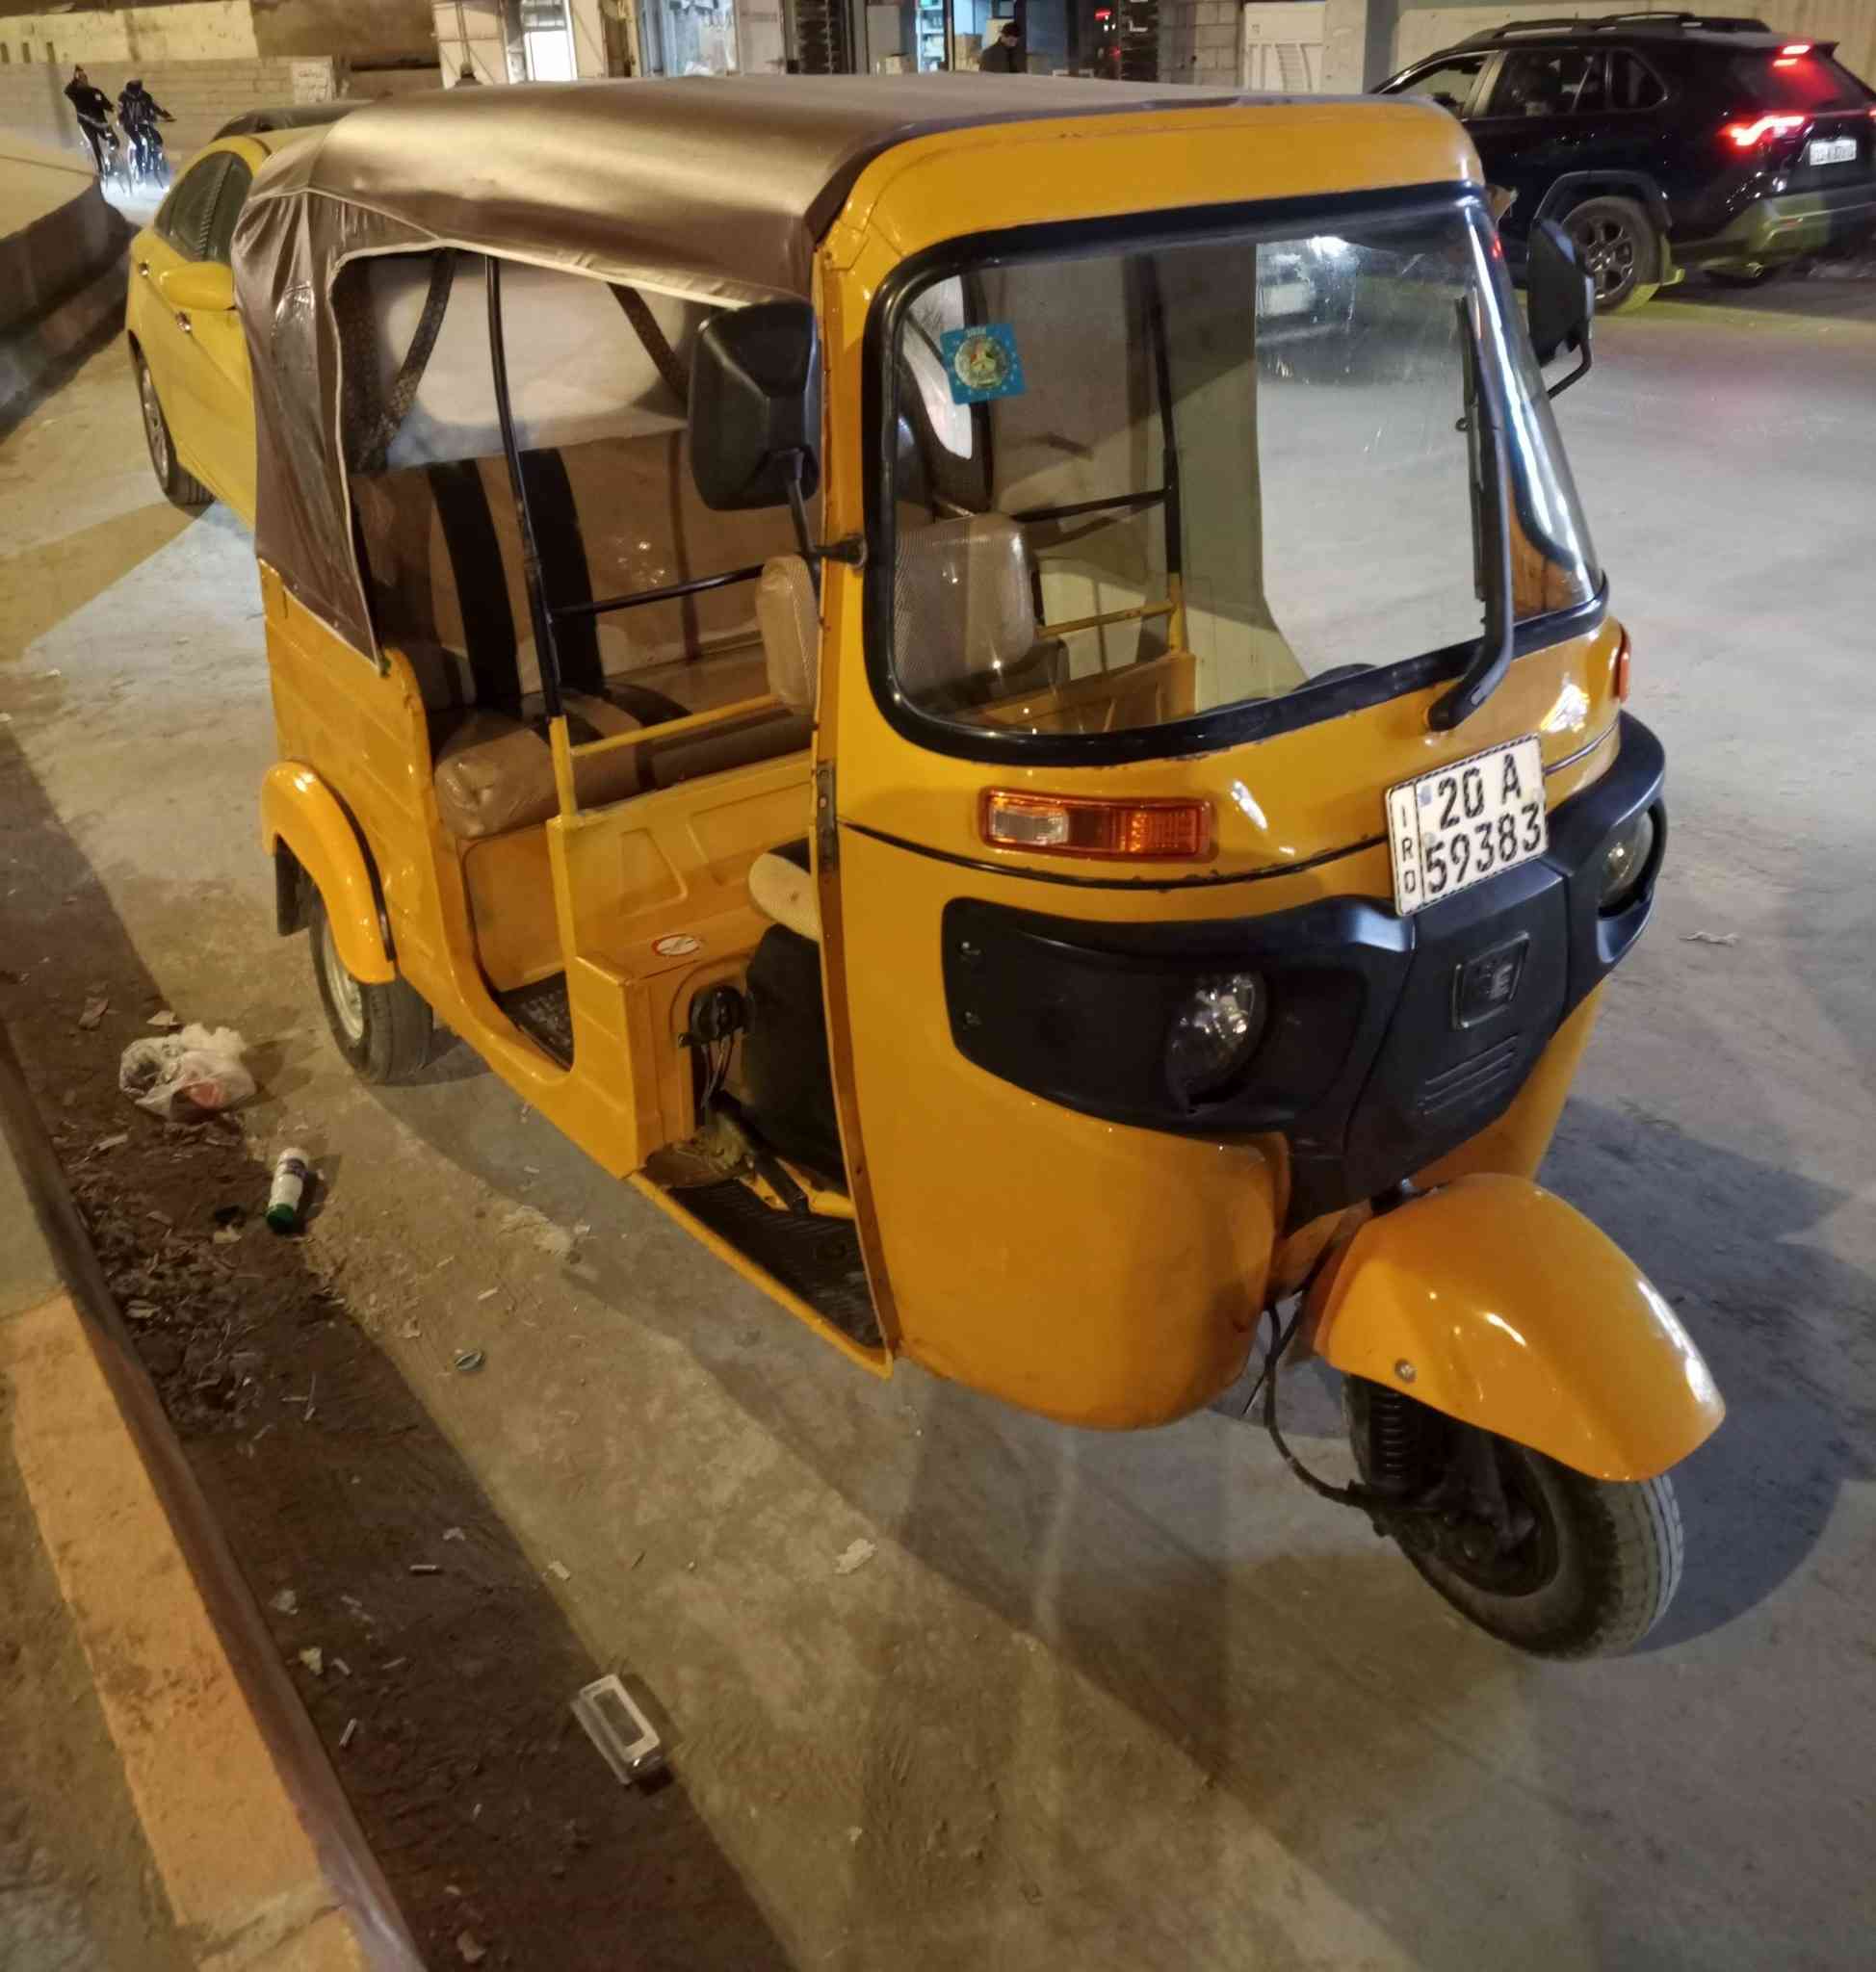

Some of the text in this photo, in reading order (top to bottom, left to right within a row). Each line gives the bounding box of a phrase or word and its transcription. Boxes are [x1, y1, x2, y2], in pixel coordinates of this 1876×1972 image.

[1438, 753, 1522, 831] 20 A
[1425, 802, 1542, 894] 59383
